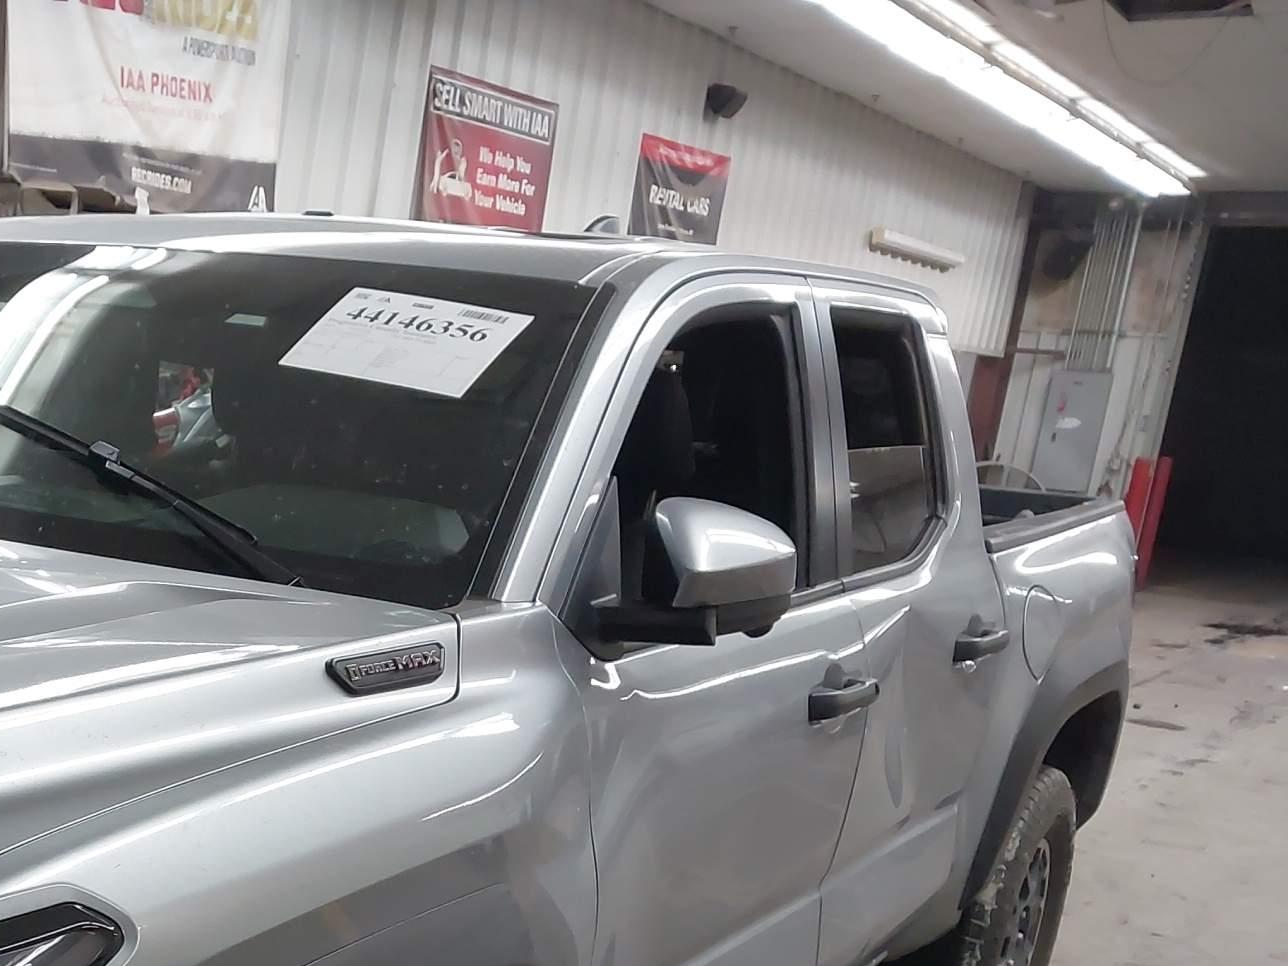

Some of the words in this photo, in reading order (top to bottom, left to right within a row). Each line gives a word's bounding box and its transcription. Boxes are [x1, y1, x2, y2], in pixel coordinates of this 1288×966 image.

[120, 65, 146, 93] IAA
[151, 71, 214, 103] PHOENIX
[434, 82, 461, 112] SELL
[462, 91, 503, 123] SMART
[503, 104, 531, 133] WITH
[530, 112, 549, 138] IAA
[494, 150, 515, 171] Help
[516, 155, 532, 175] You
[476, 167, 497, 187] Earn
[497, 172, 520, 194] More
[520, 177, 536, 197] For
[474, 189, 494, 209] Your
[495, 194, 526, 217] Vehicle
[346, 306, 489, 342] 44146356
[395, 650, 441, 671] MAX
